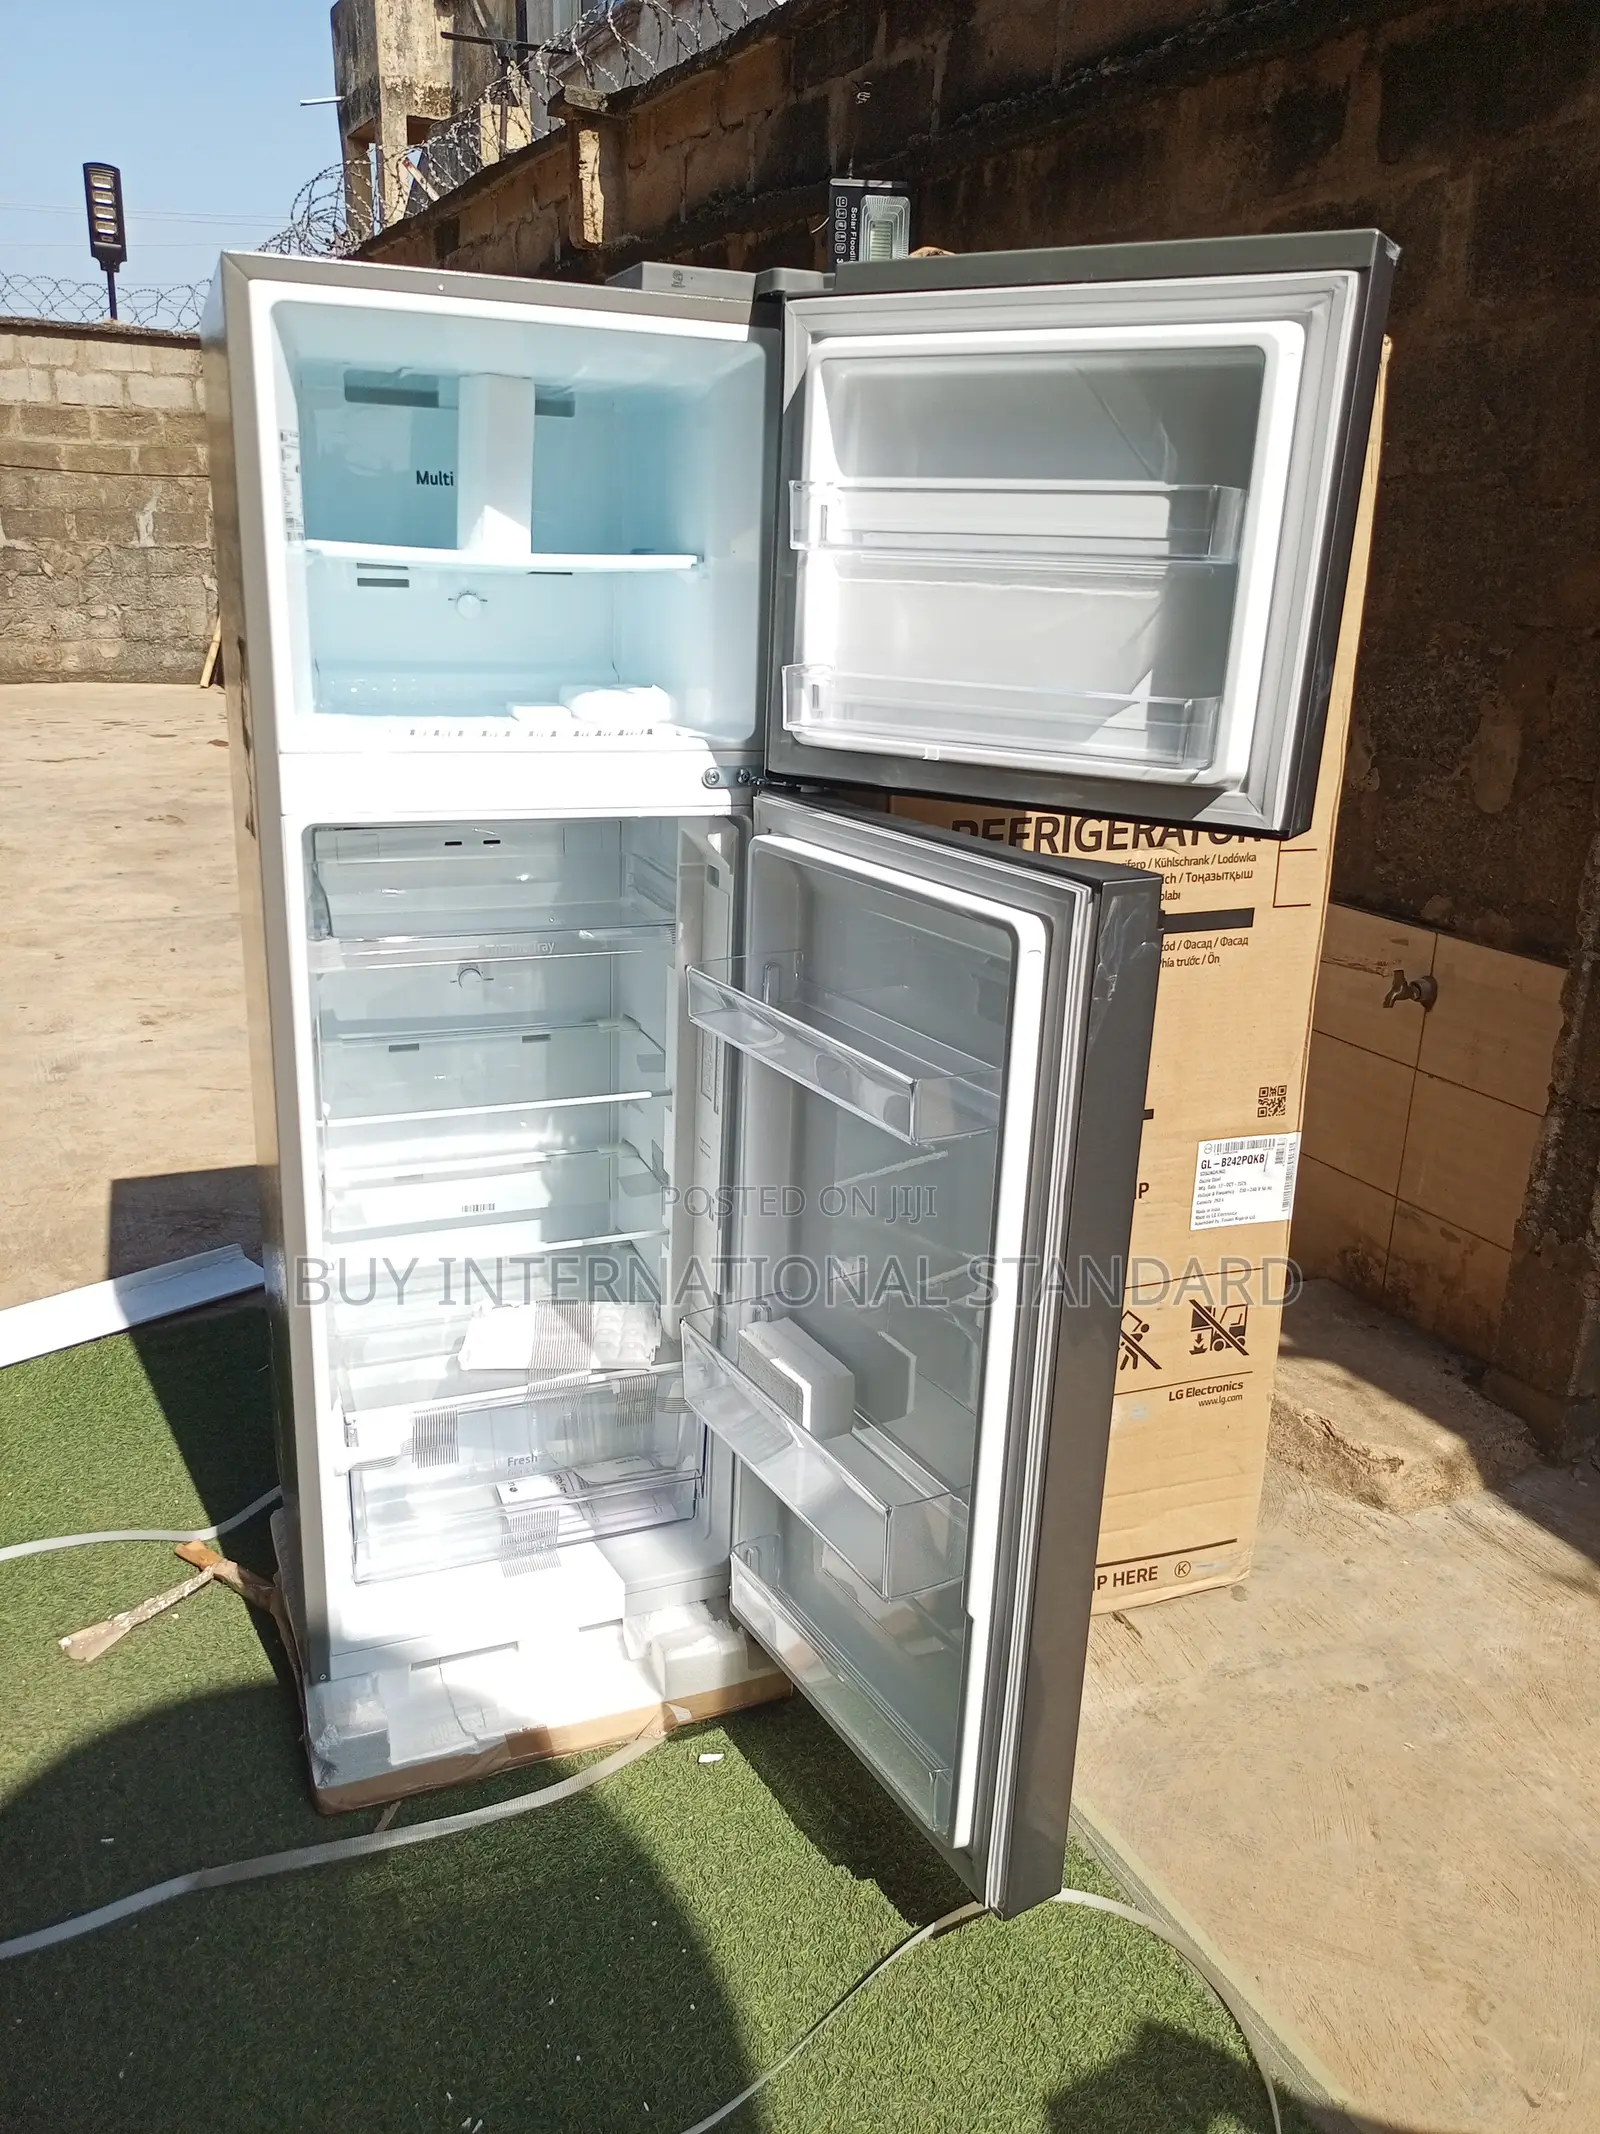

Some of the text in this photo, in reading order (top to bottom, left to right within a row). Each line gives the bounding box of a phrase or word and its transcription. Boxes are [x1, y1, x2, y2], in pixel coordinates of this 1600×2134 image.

[849, 231, 857, 262] Floodli
[416, 470, 454, 486] Multi
[1154, 856, 1210, 869] Kühlschrank
[1218, 851, 1257, 865] Lodówka
[1183, 939, 1213, 950] Фасад
[1219, 936, 1249, 947] Фасад
[1207, 952, 1220, 964] Ön
[1168, 1380, 1244, 1402] LG Electronics
[1198, 1393, 1243, 1407] www.lg.com
[1112, 1565, 1159, 1588] HERE
